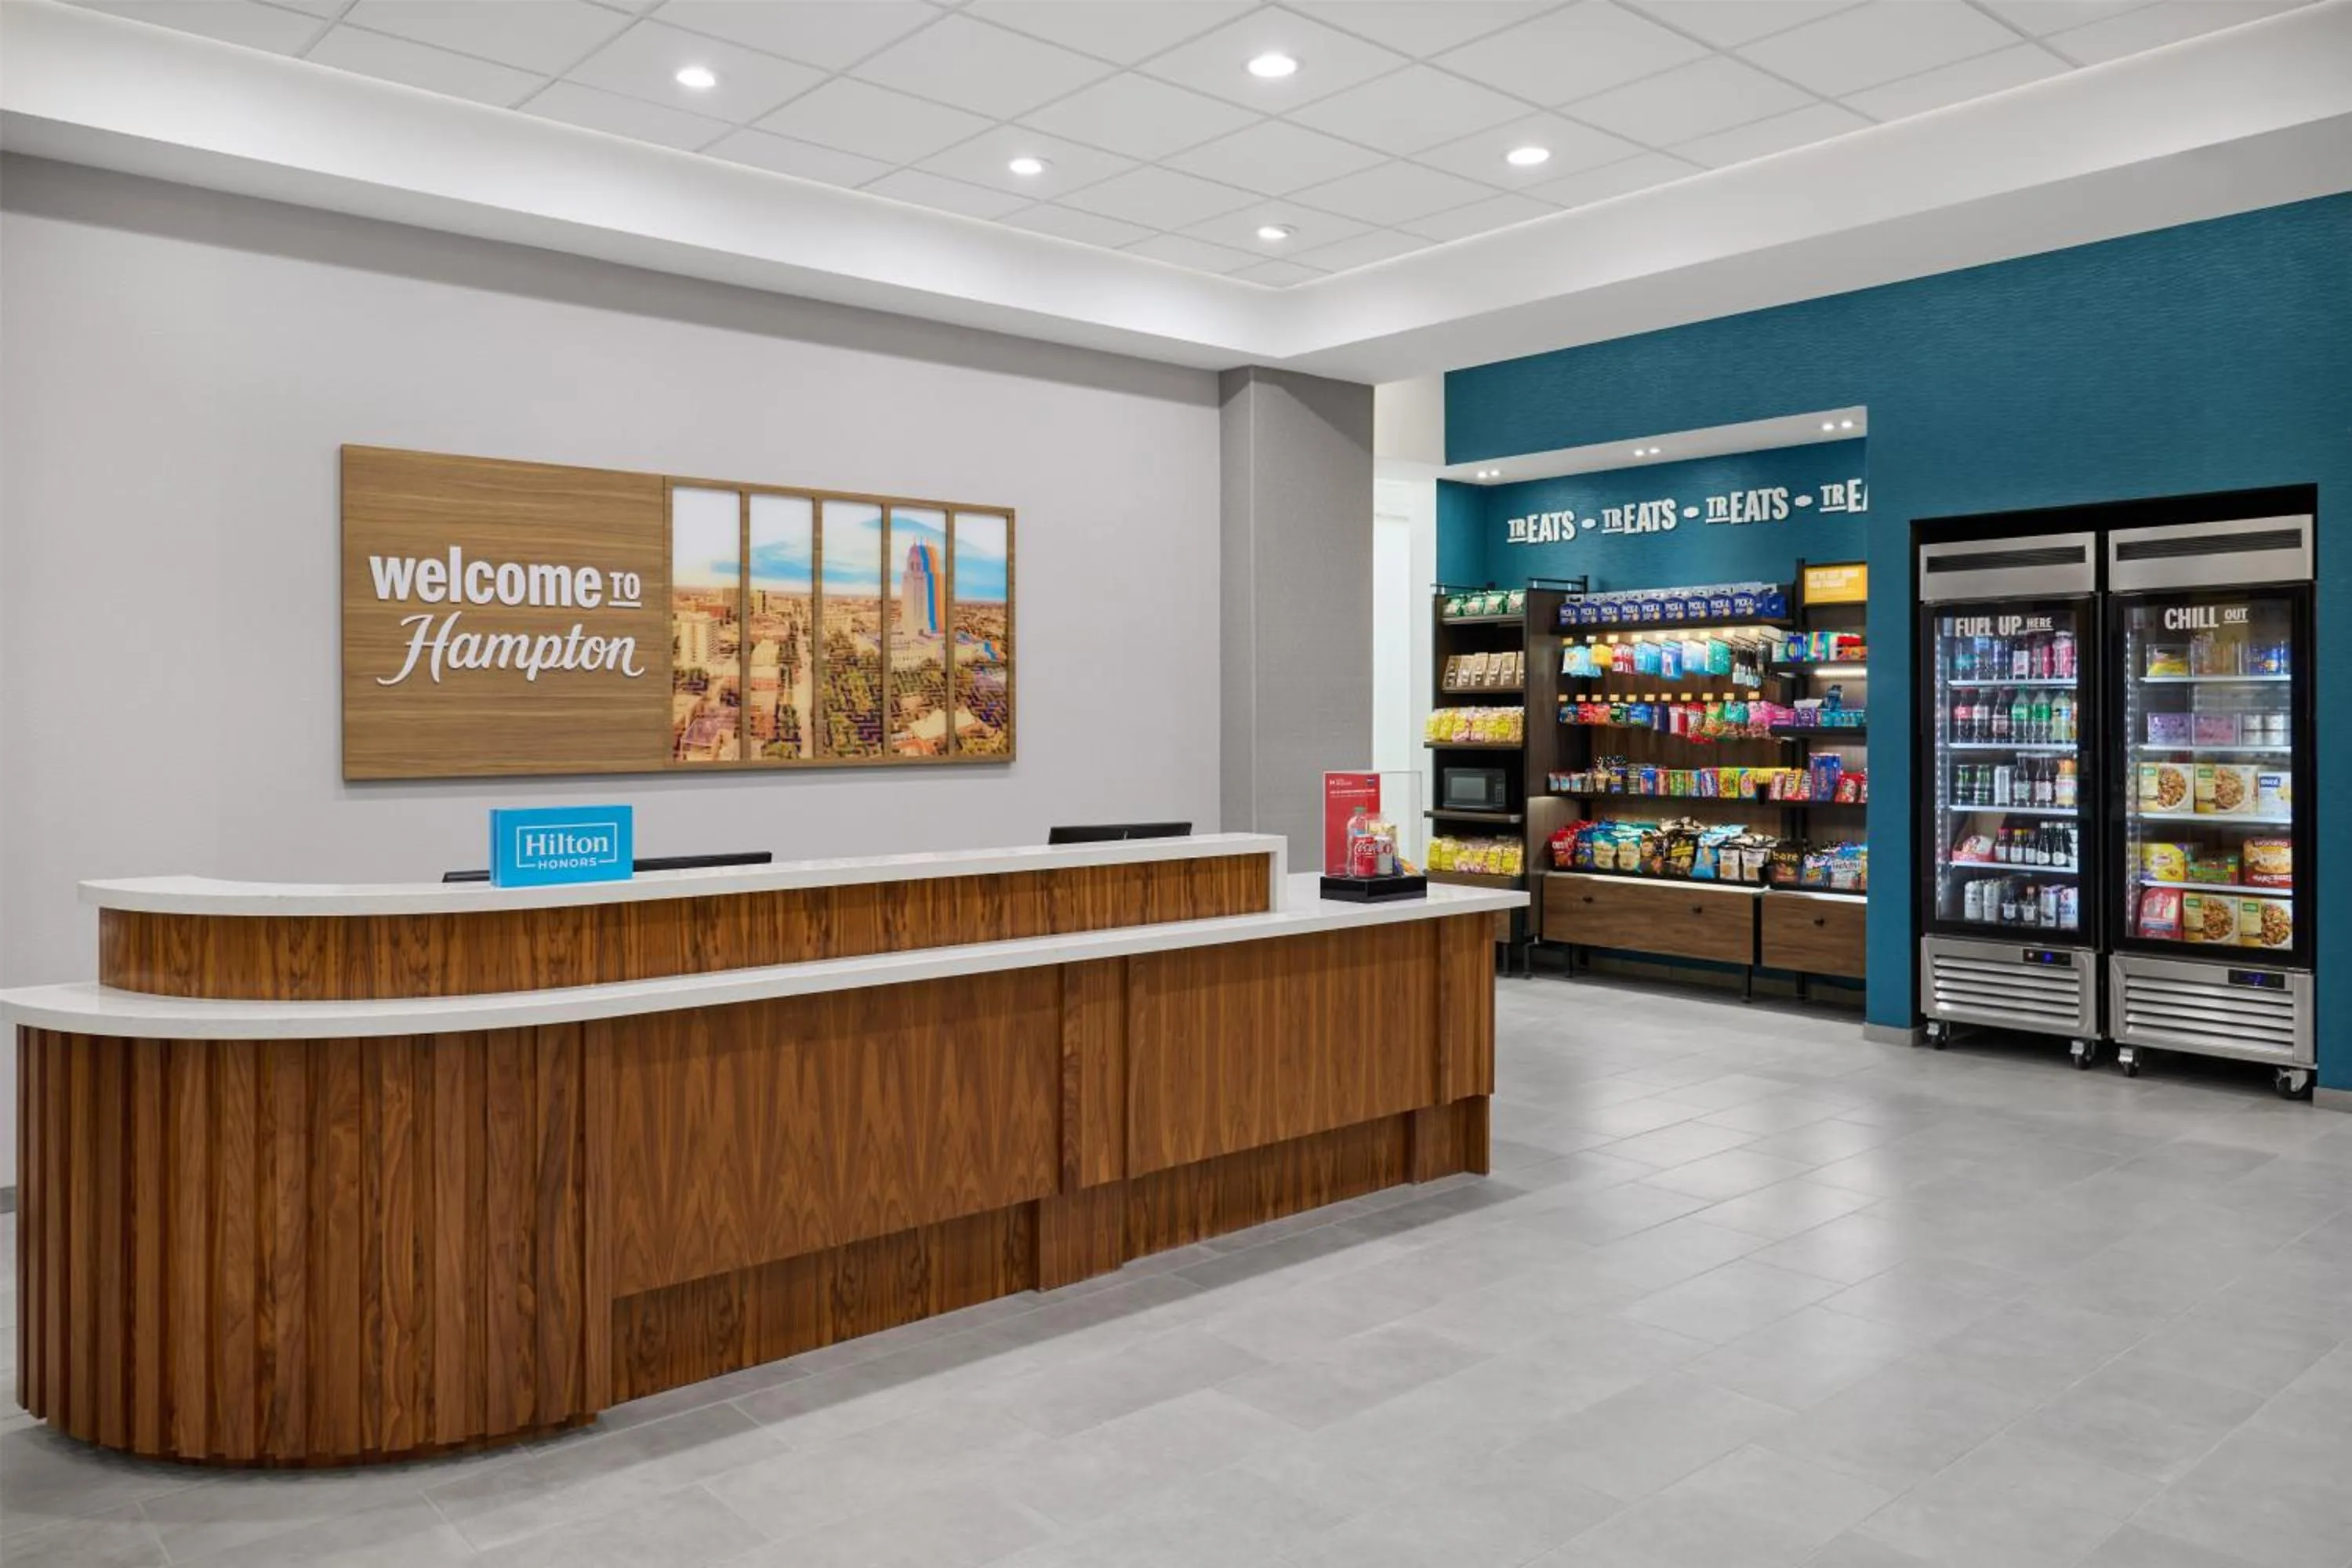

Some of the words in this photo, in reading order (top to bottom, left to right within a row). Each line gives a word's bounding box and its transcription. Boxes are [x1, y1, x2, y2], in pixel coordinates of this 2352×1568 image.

[369, 545, 603, 608] welcome
[608, 572, 642, 608] TO
[1955, 617, 1994, 637] FUEL
[1998, 615, 2022, 636] UP
[2164, 606, 2220, 630] CHILL
[2223, 608, 2249, 624] OUT
[376, 611, 645, 685] Hampton
[525, 833, 608, 856] Hilton
[538, 857, 597, 869] HONORS
